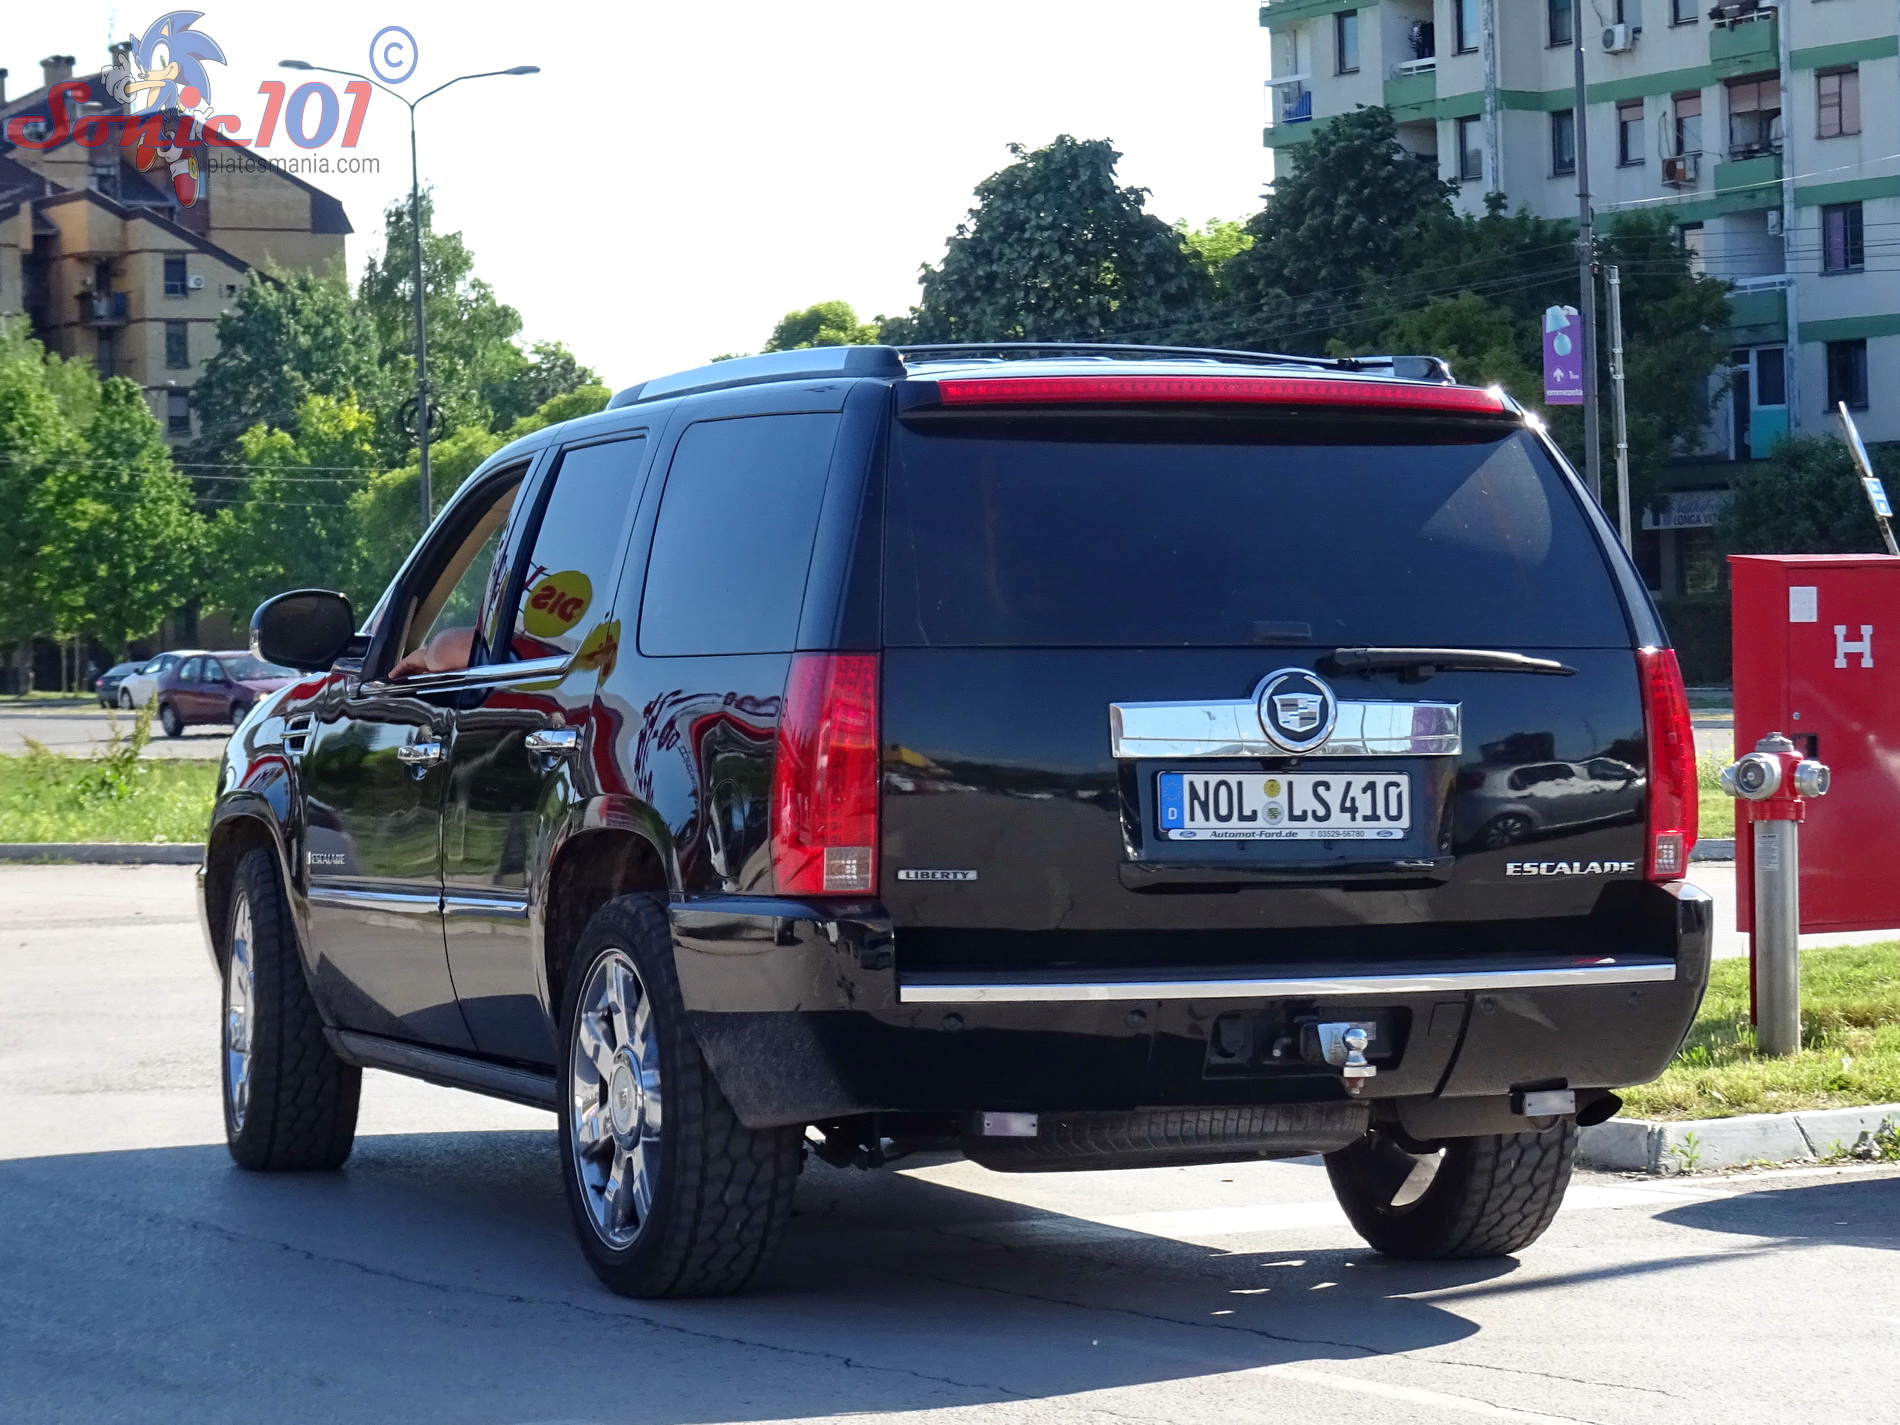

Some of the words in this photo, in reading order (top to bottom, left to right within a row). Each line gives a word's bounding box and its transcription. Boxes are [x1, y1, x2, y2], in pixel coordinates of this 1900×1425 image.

[1833, 624, 1874, 669] H
[1188, 779, 1258, 823] NOL
[1168, 807, 1178, 820] D
[1210, 829, 1298, 839] Automot-Ford.de
[1317, 829, 1365, 838] 03529-56780
[905, 871, 970, 879] LIBERTY
[1506, 861, 1636, 876] ESCALADE
